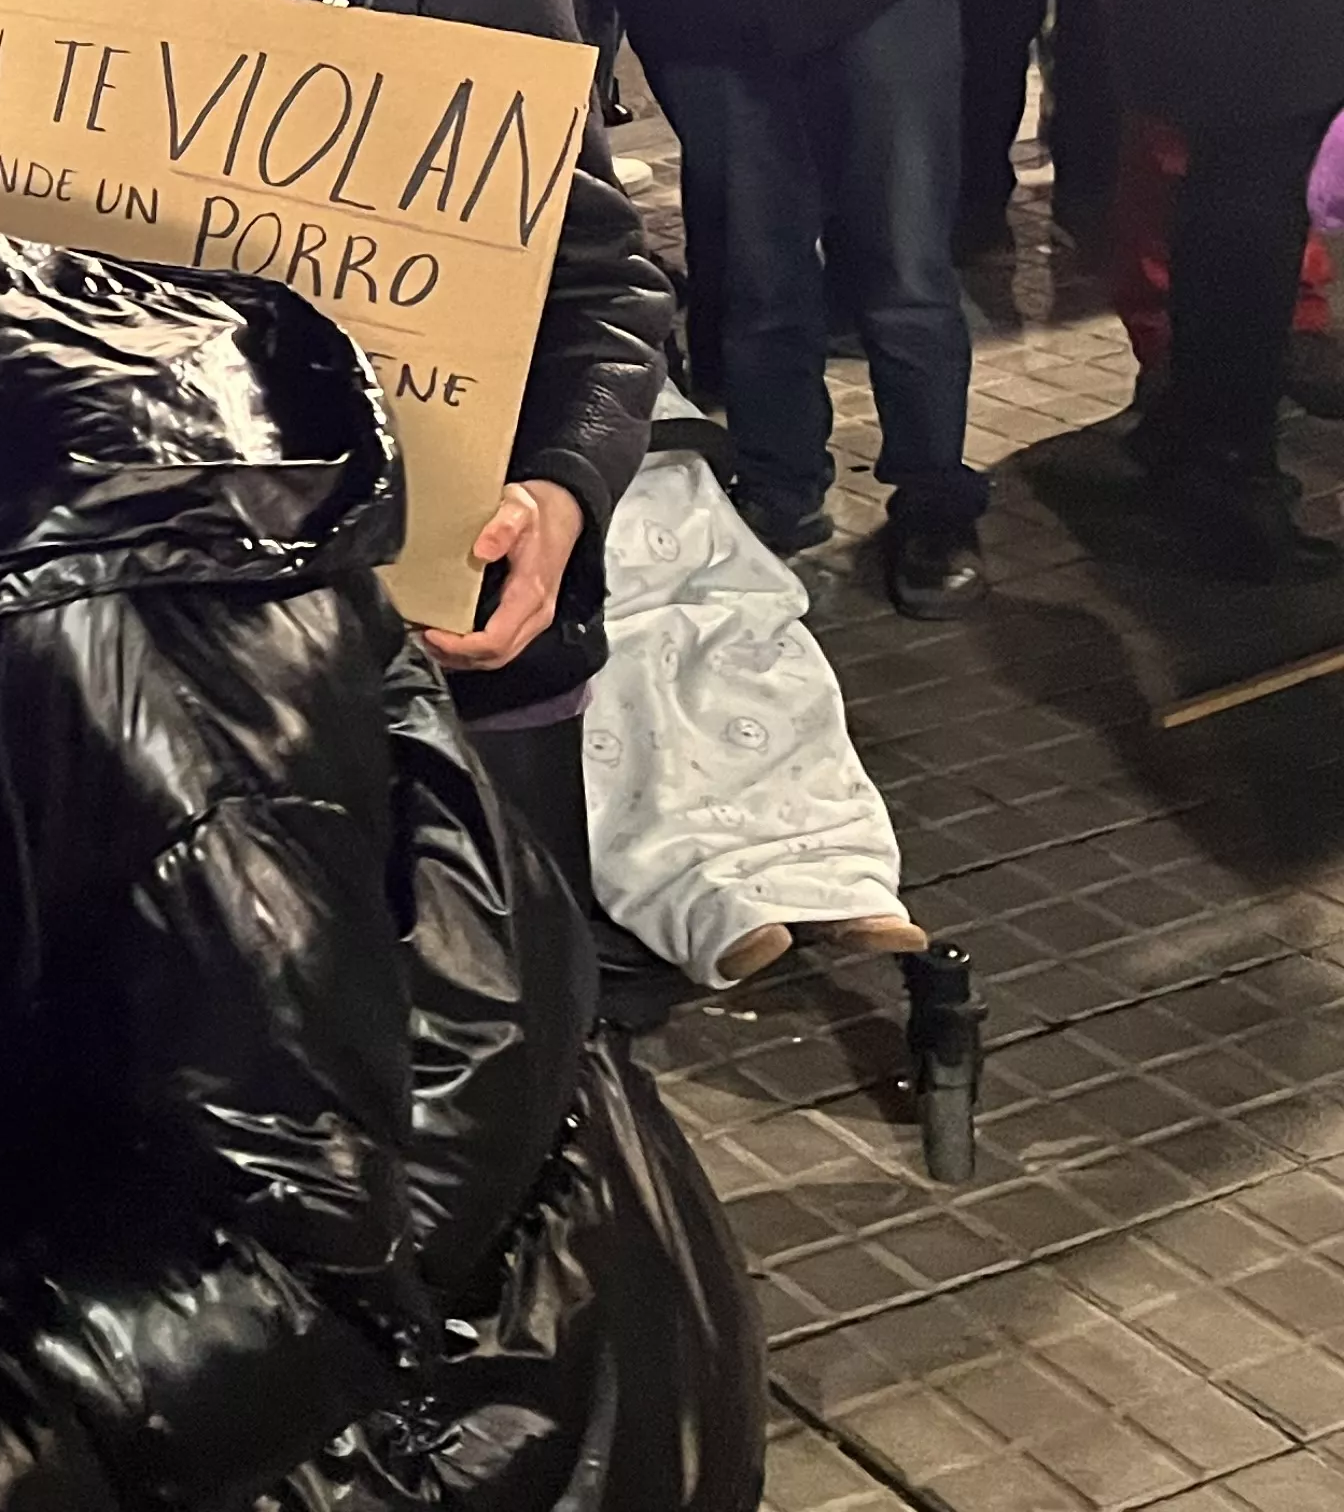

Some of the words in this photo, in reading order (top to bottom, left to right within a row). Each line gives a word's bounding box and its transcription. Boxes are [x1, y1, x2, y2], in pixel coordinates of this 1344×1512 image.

[53, 40, 131, 132] TE
[160, 41, 579, 247] VIOLAN
[96, 179, 158, 224] UN
[193, 195, 439, 307] PORRO
